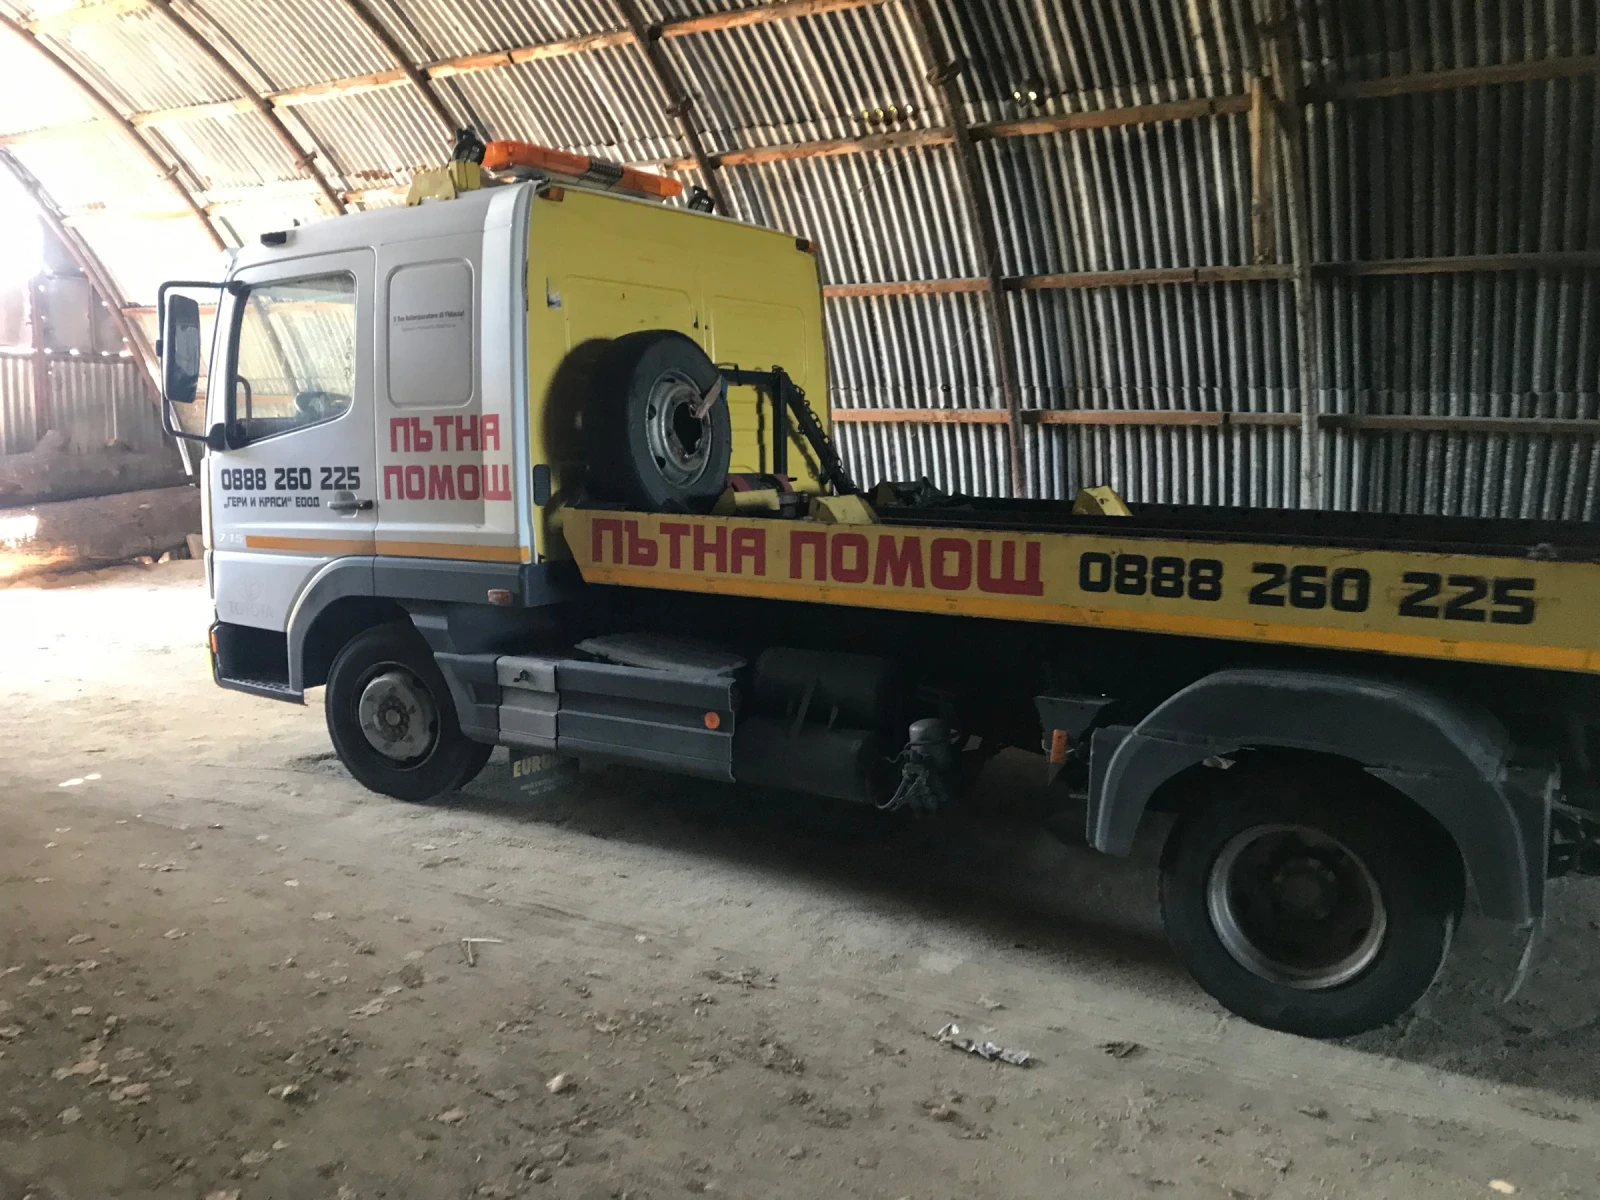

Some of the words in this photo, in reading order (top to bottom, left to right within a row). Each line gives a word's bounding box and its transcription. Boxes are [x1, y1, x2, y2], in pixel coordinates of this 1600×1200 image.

[390, 414, 500, 452] ПЪТНА
[221, 468, 267, 490] 0888
[274, 467, 312, 490] 260
[320, 466, 361, 490] 225
[383, 464, 512, 501] ПОМОЩ
[250, 496, 257, 507] И
[295, 496, 320, 508] ЕООД
[592, 517, 766, 576] ПЪТНА
[789, 530, 1044, 597] ПОМОЩ
[1079, 551, 1223, 602] 0888
[1248, 562, 1371, 613] 260
[1398, 571, 1536, 625] 225
